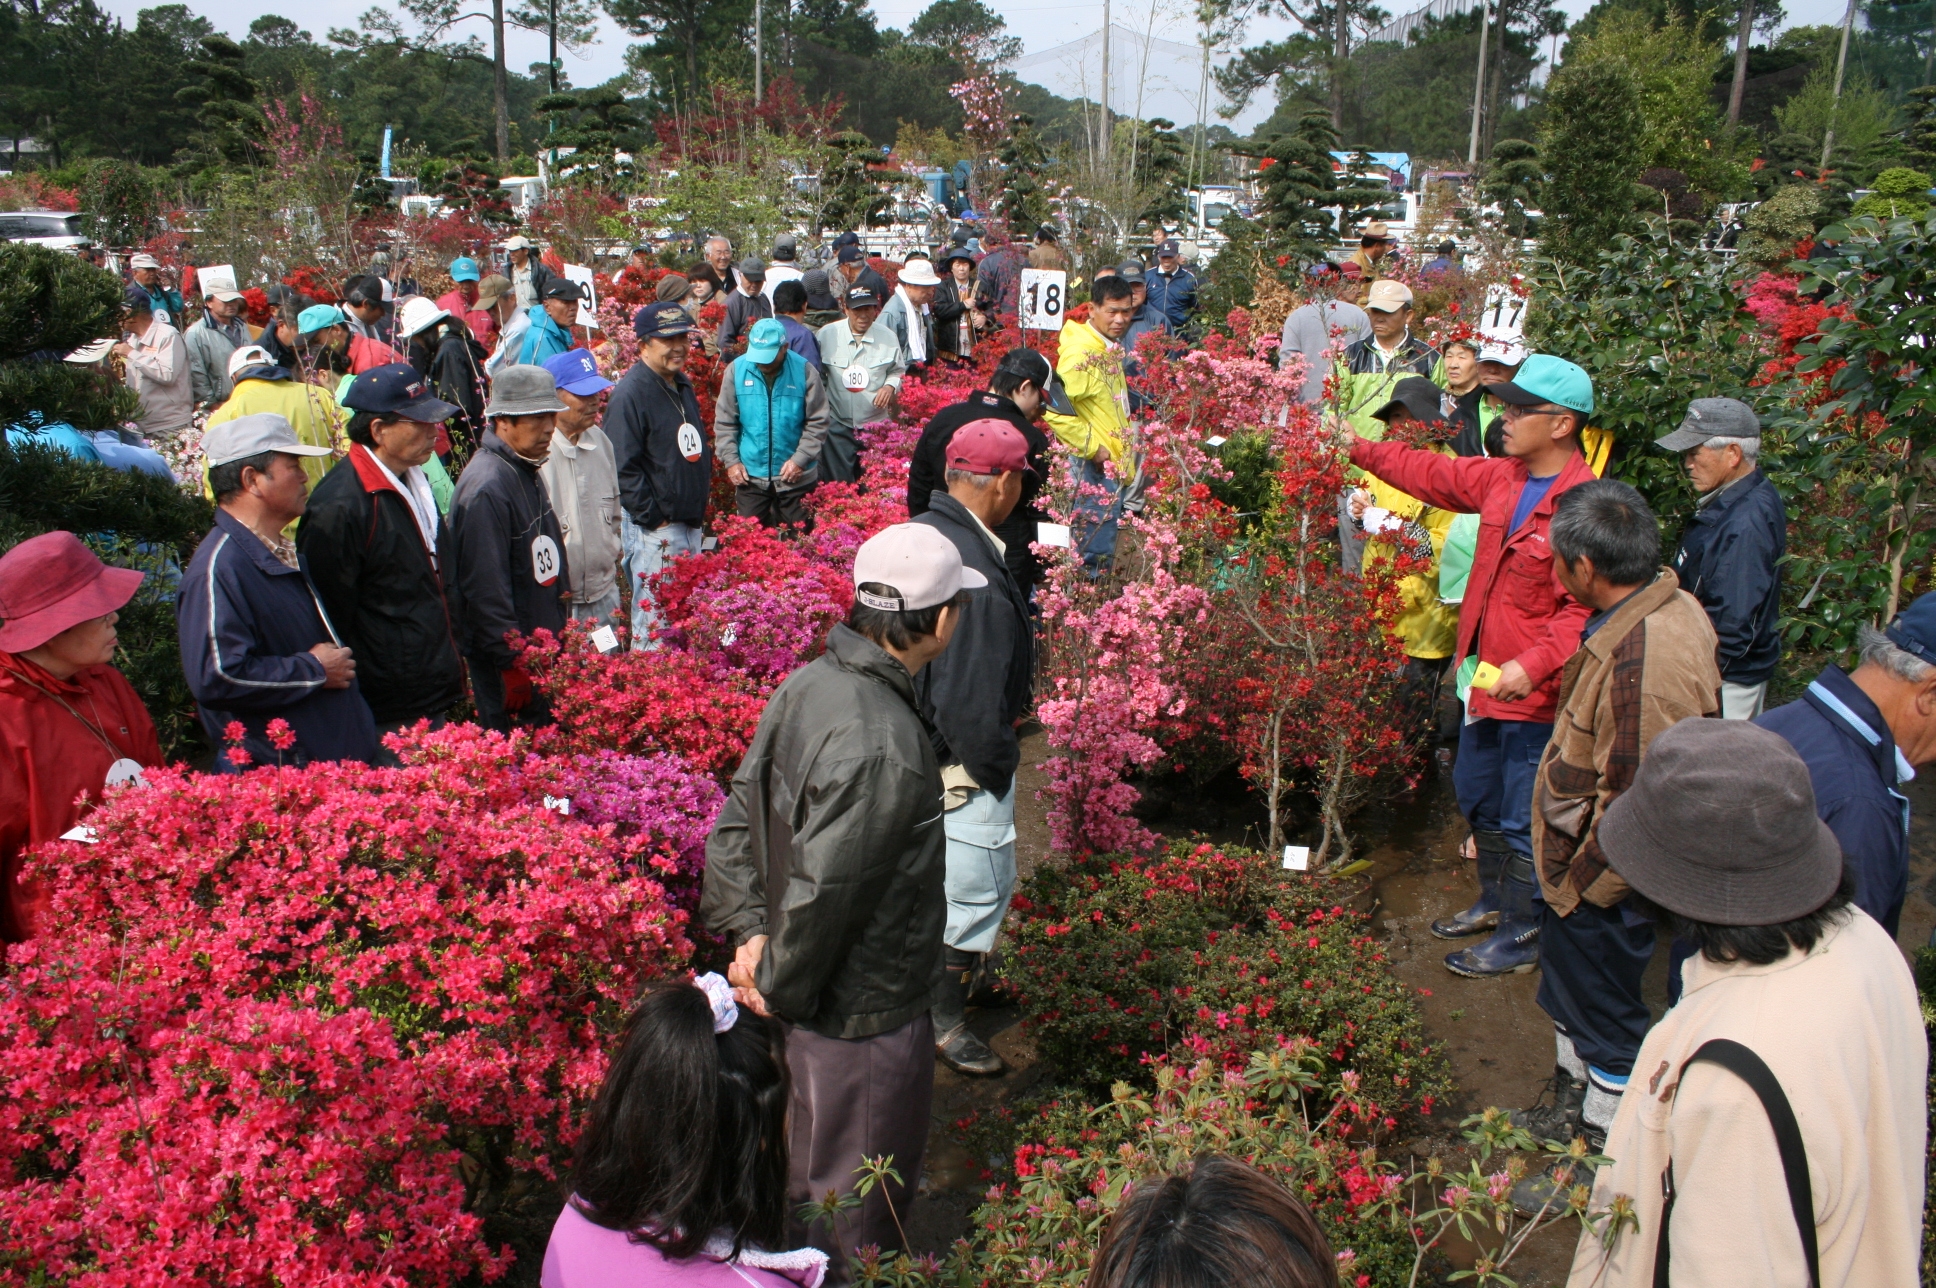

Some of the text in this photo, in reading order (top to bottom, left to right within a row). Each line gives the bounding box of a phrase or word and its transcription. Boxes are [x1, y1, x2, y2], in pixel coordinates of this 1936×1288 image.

[1027, 282, 1061, 316] 18
[1492, 300, 1523, 328] 17
[849, 373, 863, 385] 180
[684, 433, 696, 452] 24
[537, 548, 553, 574] 33
